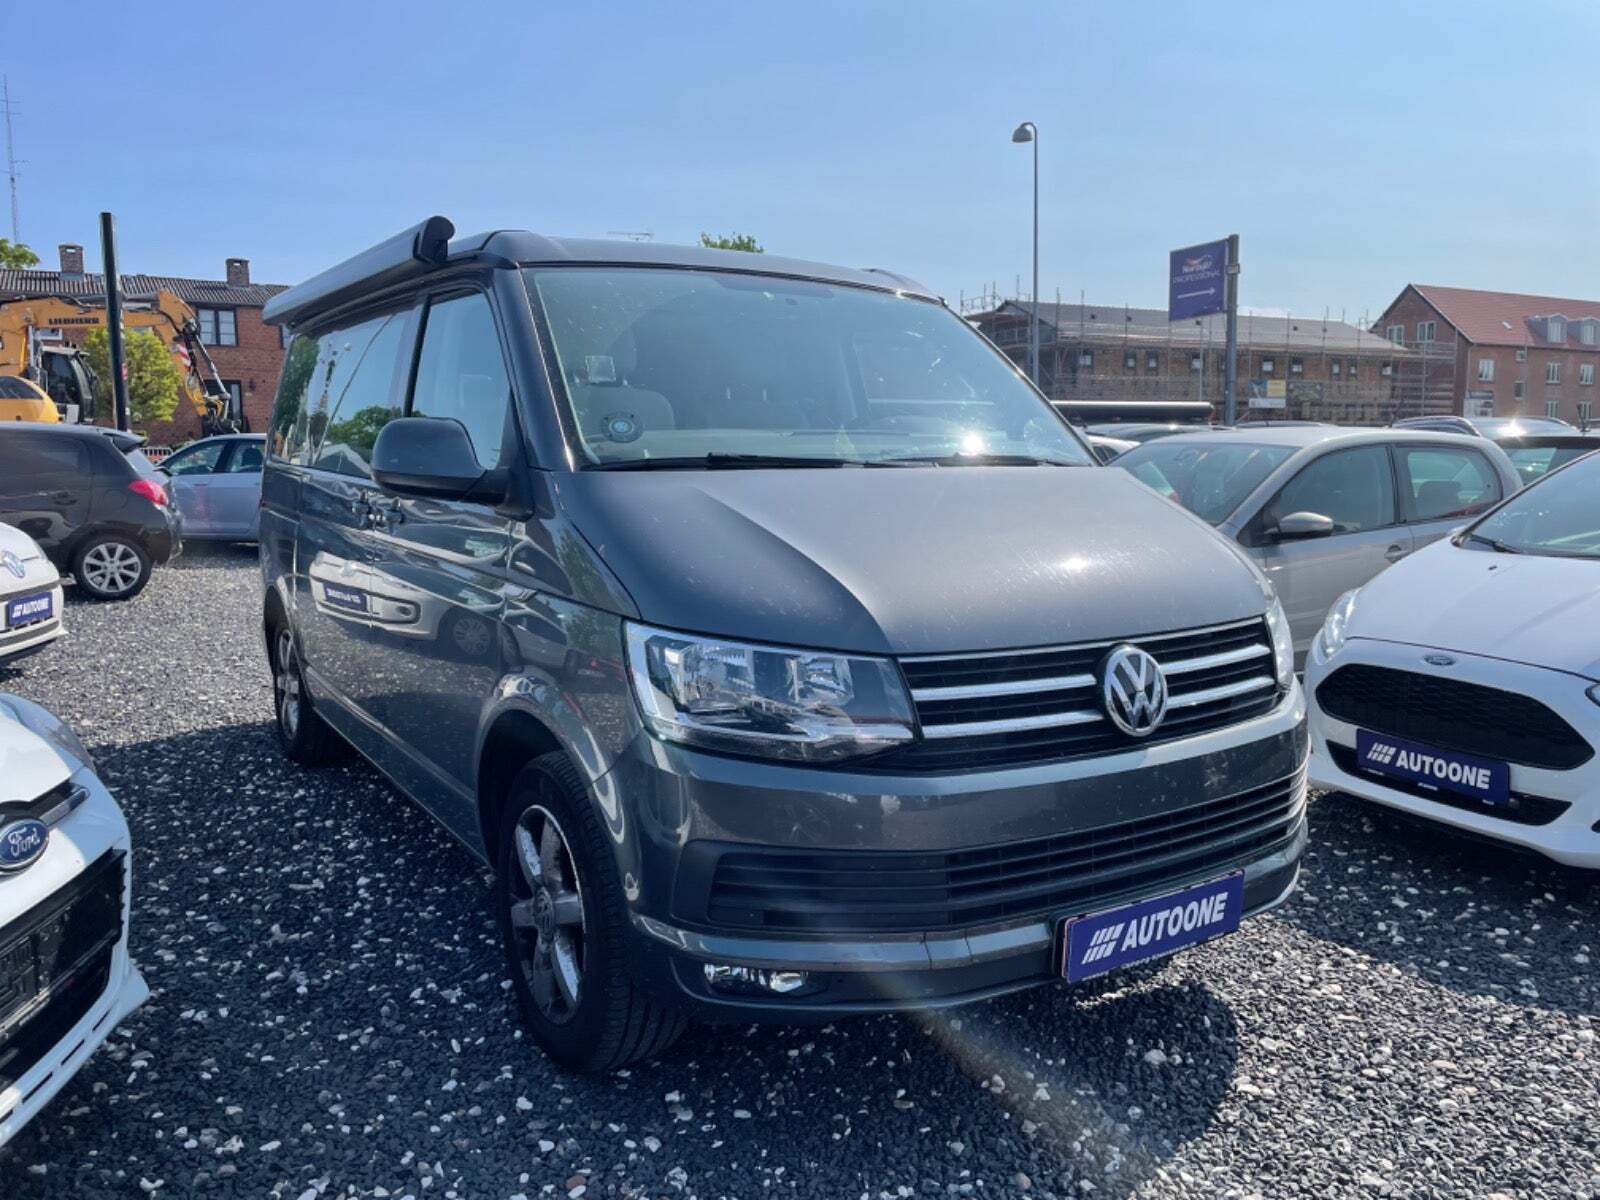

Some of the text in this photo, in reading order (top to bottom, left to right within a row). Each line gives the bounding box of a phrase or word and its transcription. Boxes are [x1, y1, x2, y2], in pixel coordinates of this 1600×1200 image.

[1396, 750, 1491, 789] AUTOONE
[8, 827, 40, 857] Ford
[1121, 892, 1228, 952] AUTOONE
